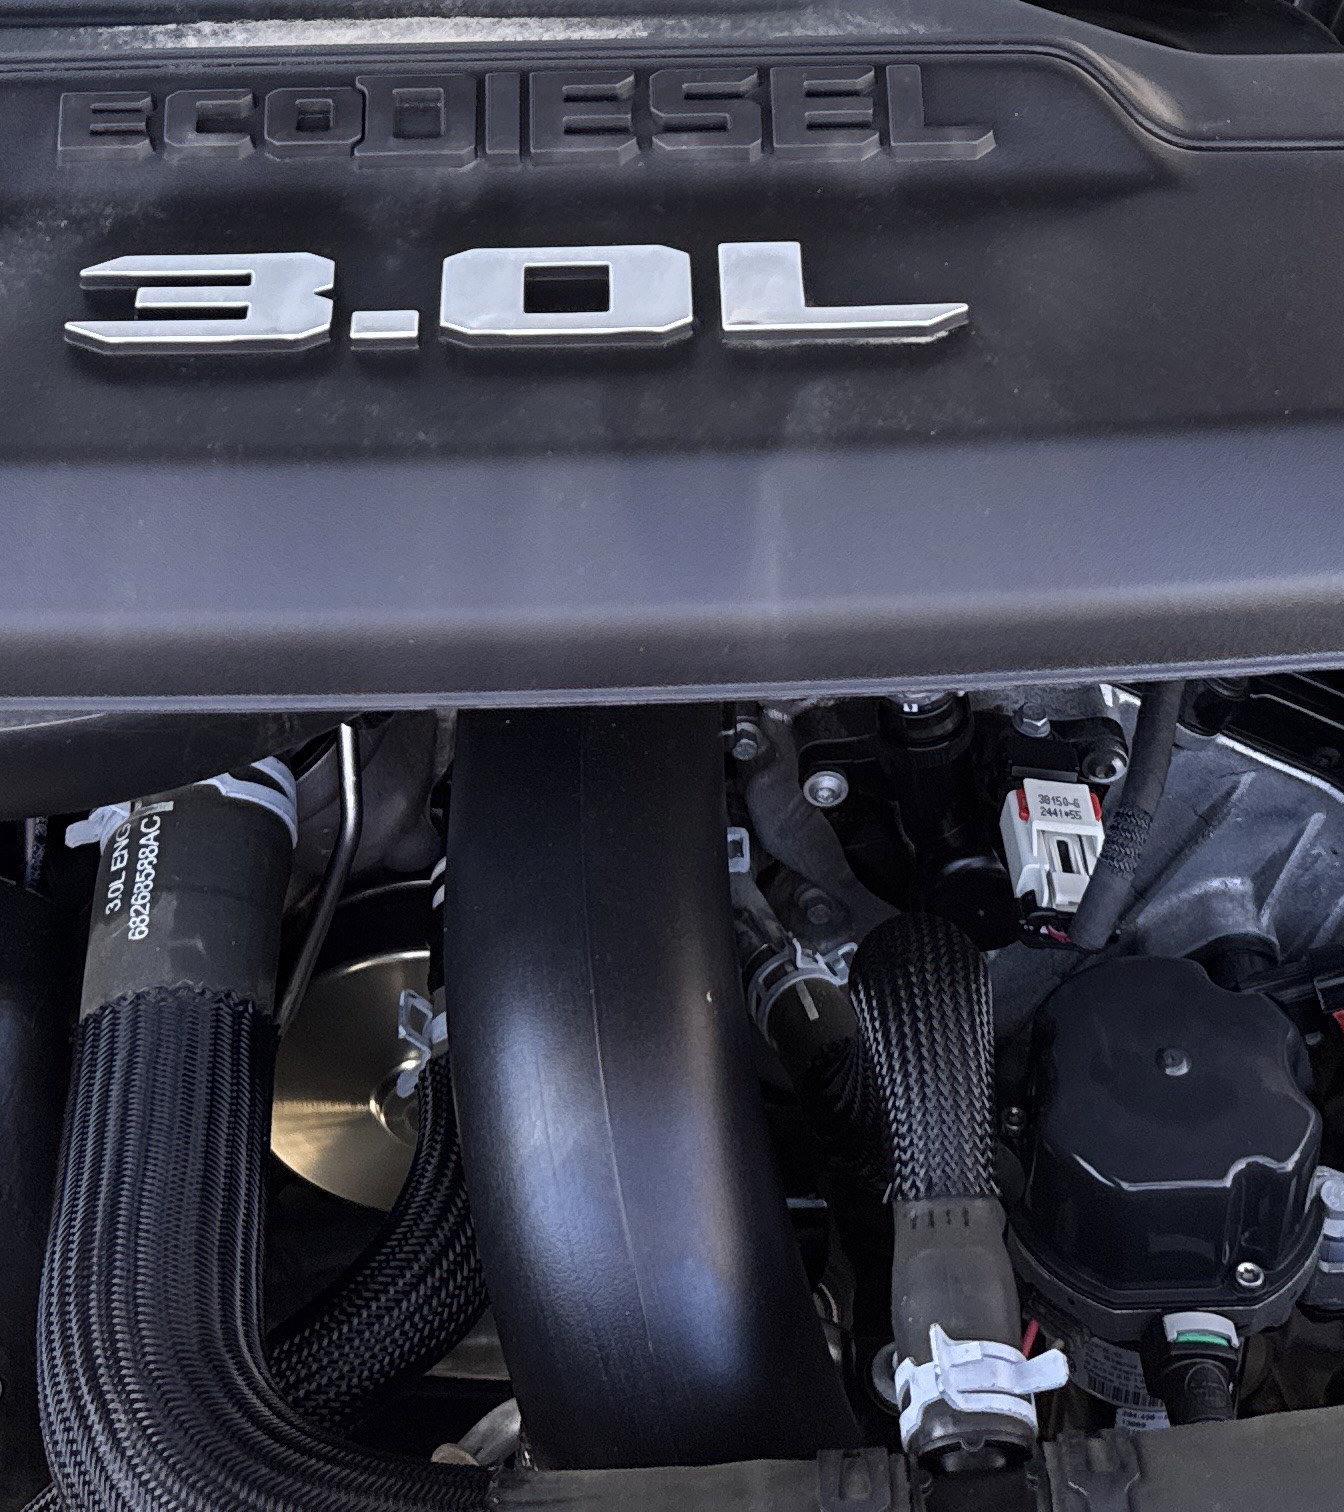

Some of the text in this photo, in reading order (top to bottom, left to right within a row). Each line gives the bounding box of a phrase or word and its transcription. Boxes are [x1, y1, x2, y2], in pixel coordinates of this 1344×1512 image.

[57, 64, 997, 170] ECODIESEL
[63, 240, 972, 355] 3.0L
[106, 822, 132, 915] 3.0L ENG
[127, 815, 161, 941] 68268588AC
